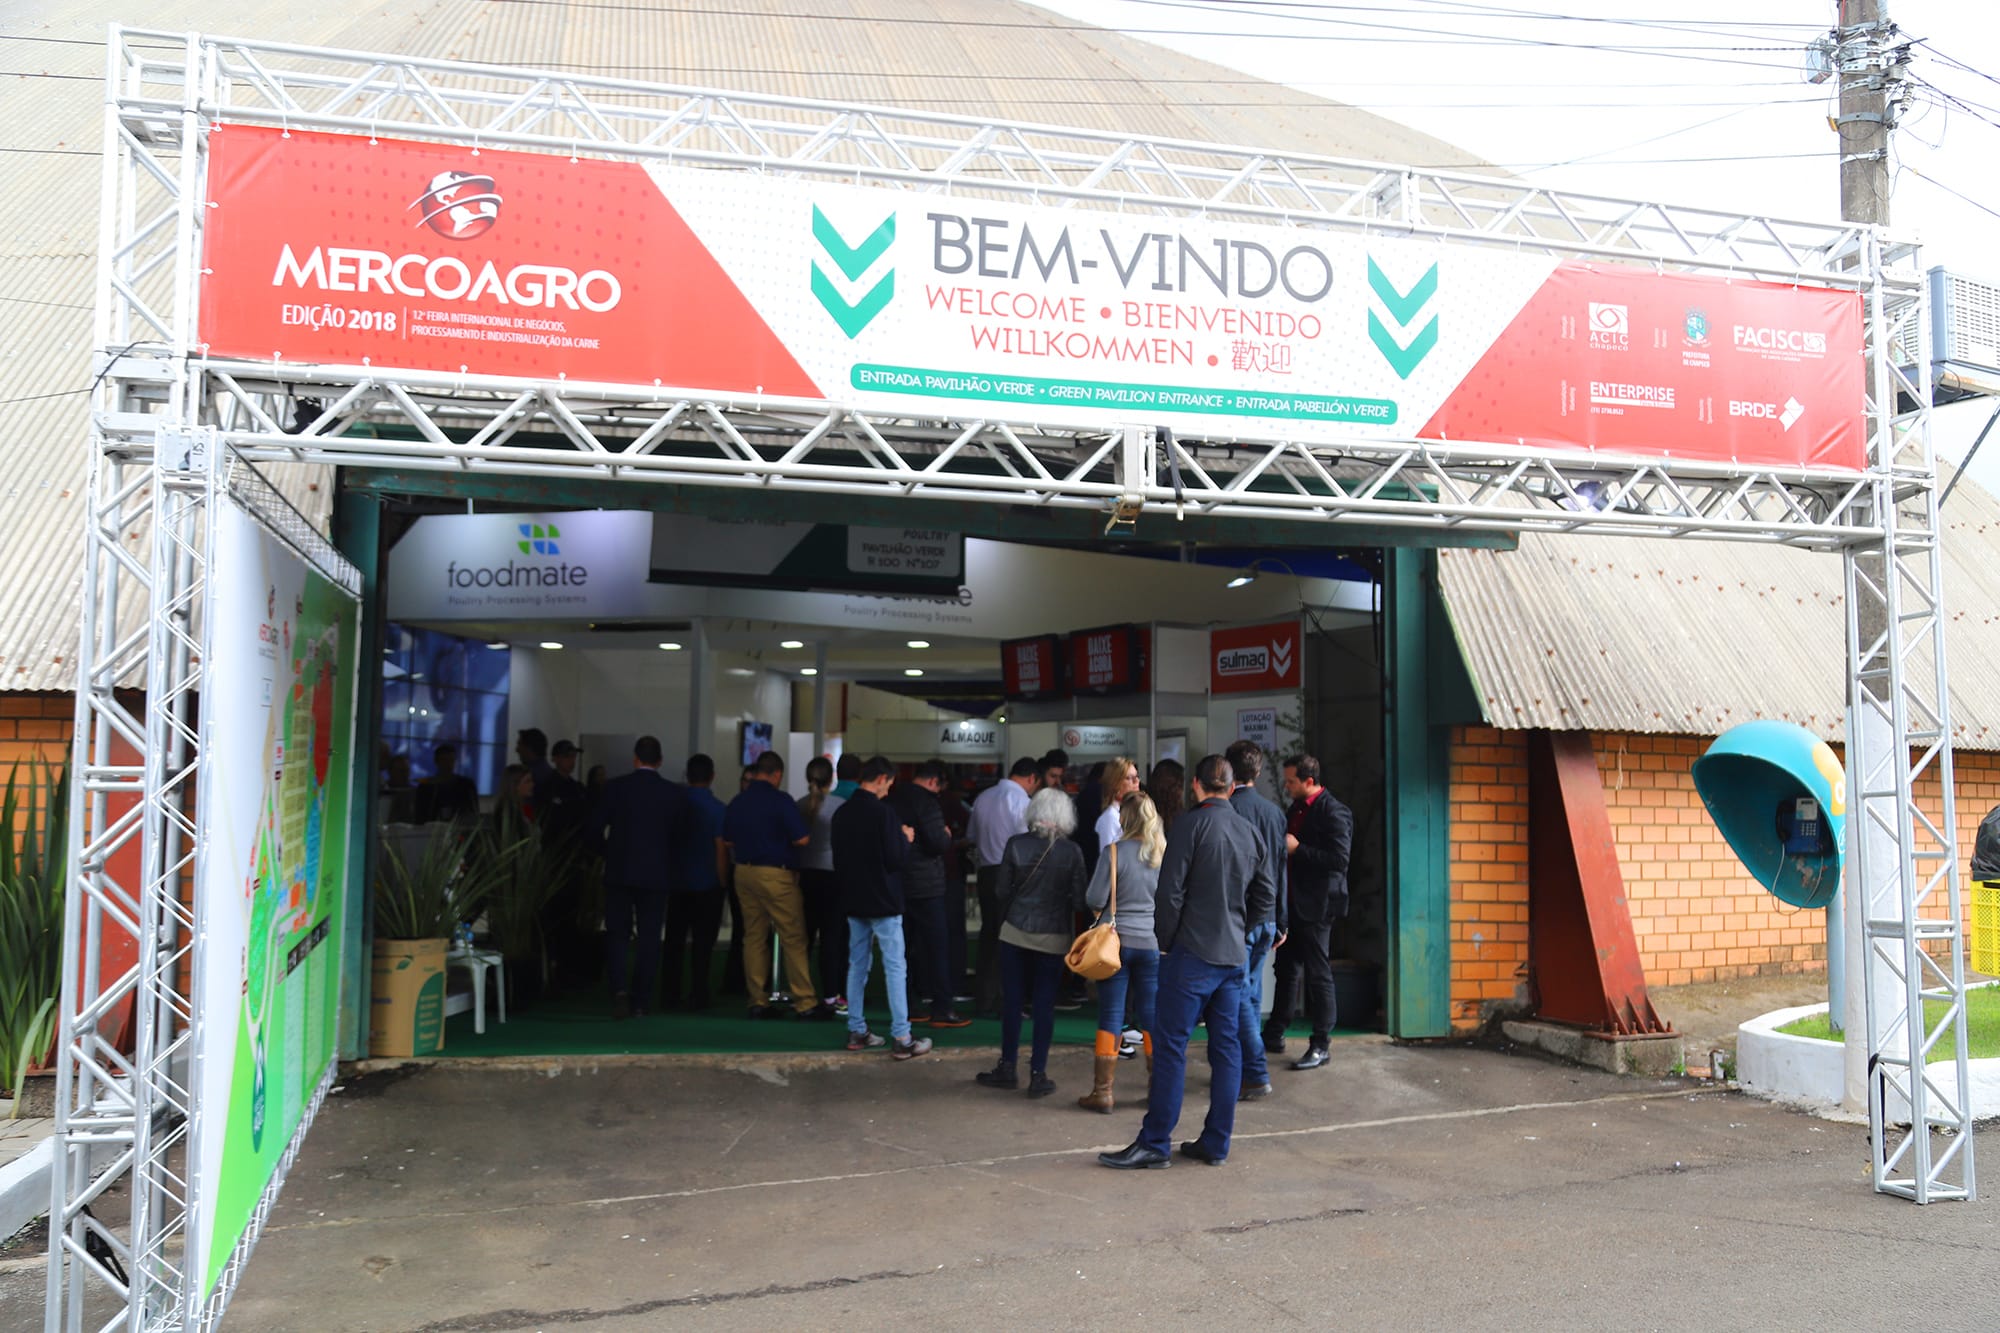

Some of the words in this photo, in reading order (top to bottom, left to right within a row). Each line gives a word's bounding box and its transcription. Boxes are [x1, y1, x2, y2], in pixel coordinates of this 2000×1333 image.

[926, 212, 1334, 303] BEM-VINDO
[272, 243, 622, 313] MERCOAGRO
[281, 303, 346, 331] EDIÇÃO
[348, 309, 397, 332] 2018
[426, 311, 450, 322] FEIRA
[451, 313, 512, 328] INTERNACIONAL
[513, 318, 525, 328] DE
[925, 284, 1085, 323] WELCOME
[1122, 300, 1322, 340] BIENVENIDO
[411, 325, 480, 341] PROCESSAMENTO
[481, 331, 486, 340] E
[487, 330, 561, 348] INDUSTRIALIZAÇÃO
[562, 338, 573, 347] DA
[574, 338, 601, 349] CARNE
[970, 324, 1193, 366] WILLKOMMEN
[1589, 331, 1629, 345] ACIC
[1733, 325, 1800, 351] FACISC
[1231, 338, 1292, 375] 歡迎
[859, 369, 922, 388] ENTRADA
[925, 375, 991, 393] PAVILHÃO
[993, 381, 1035, 397] VERDE
[1049, 385, 1093, 400] GREEN
[1095, 388, 1156, 404] PAVILION
[1158, 392, 1224, 407] ENTRANCE
[1235, 396, 1291, 412] ENTRADA
[1294, 398, 1350, 415] PABELLÓN
[1352, 404, 1390, 418] VERDE
[1590, 381, 1675, 402] ENTERPRISE
[1729, 400, 1777, 419] BRDE
[903, 529, 950, 541] POULTRY
[862, 542, 912, 555] PAVILHÃO
[447, 560, 588, 588] foodmate
[881, 607, 932, 622] Processing
[935, 612, 973, 623] Systems
[1219, 651, 1266, 669] sulmaq
[941, 728, 996, 744] ALMAQUE
